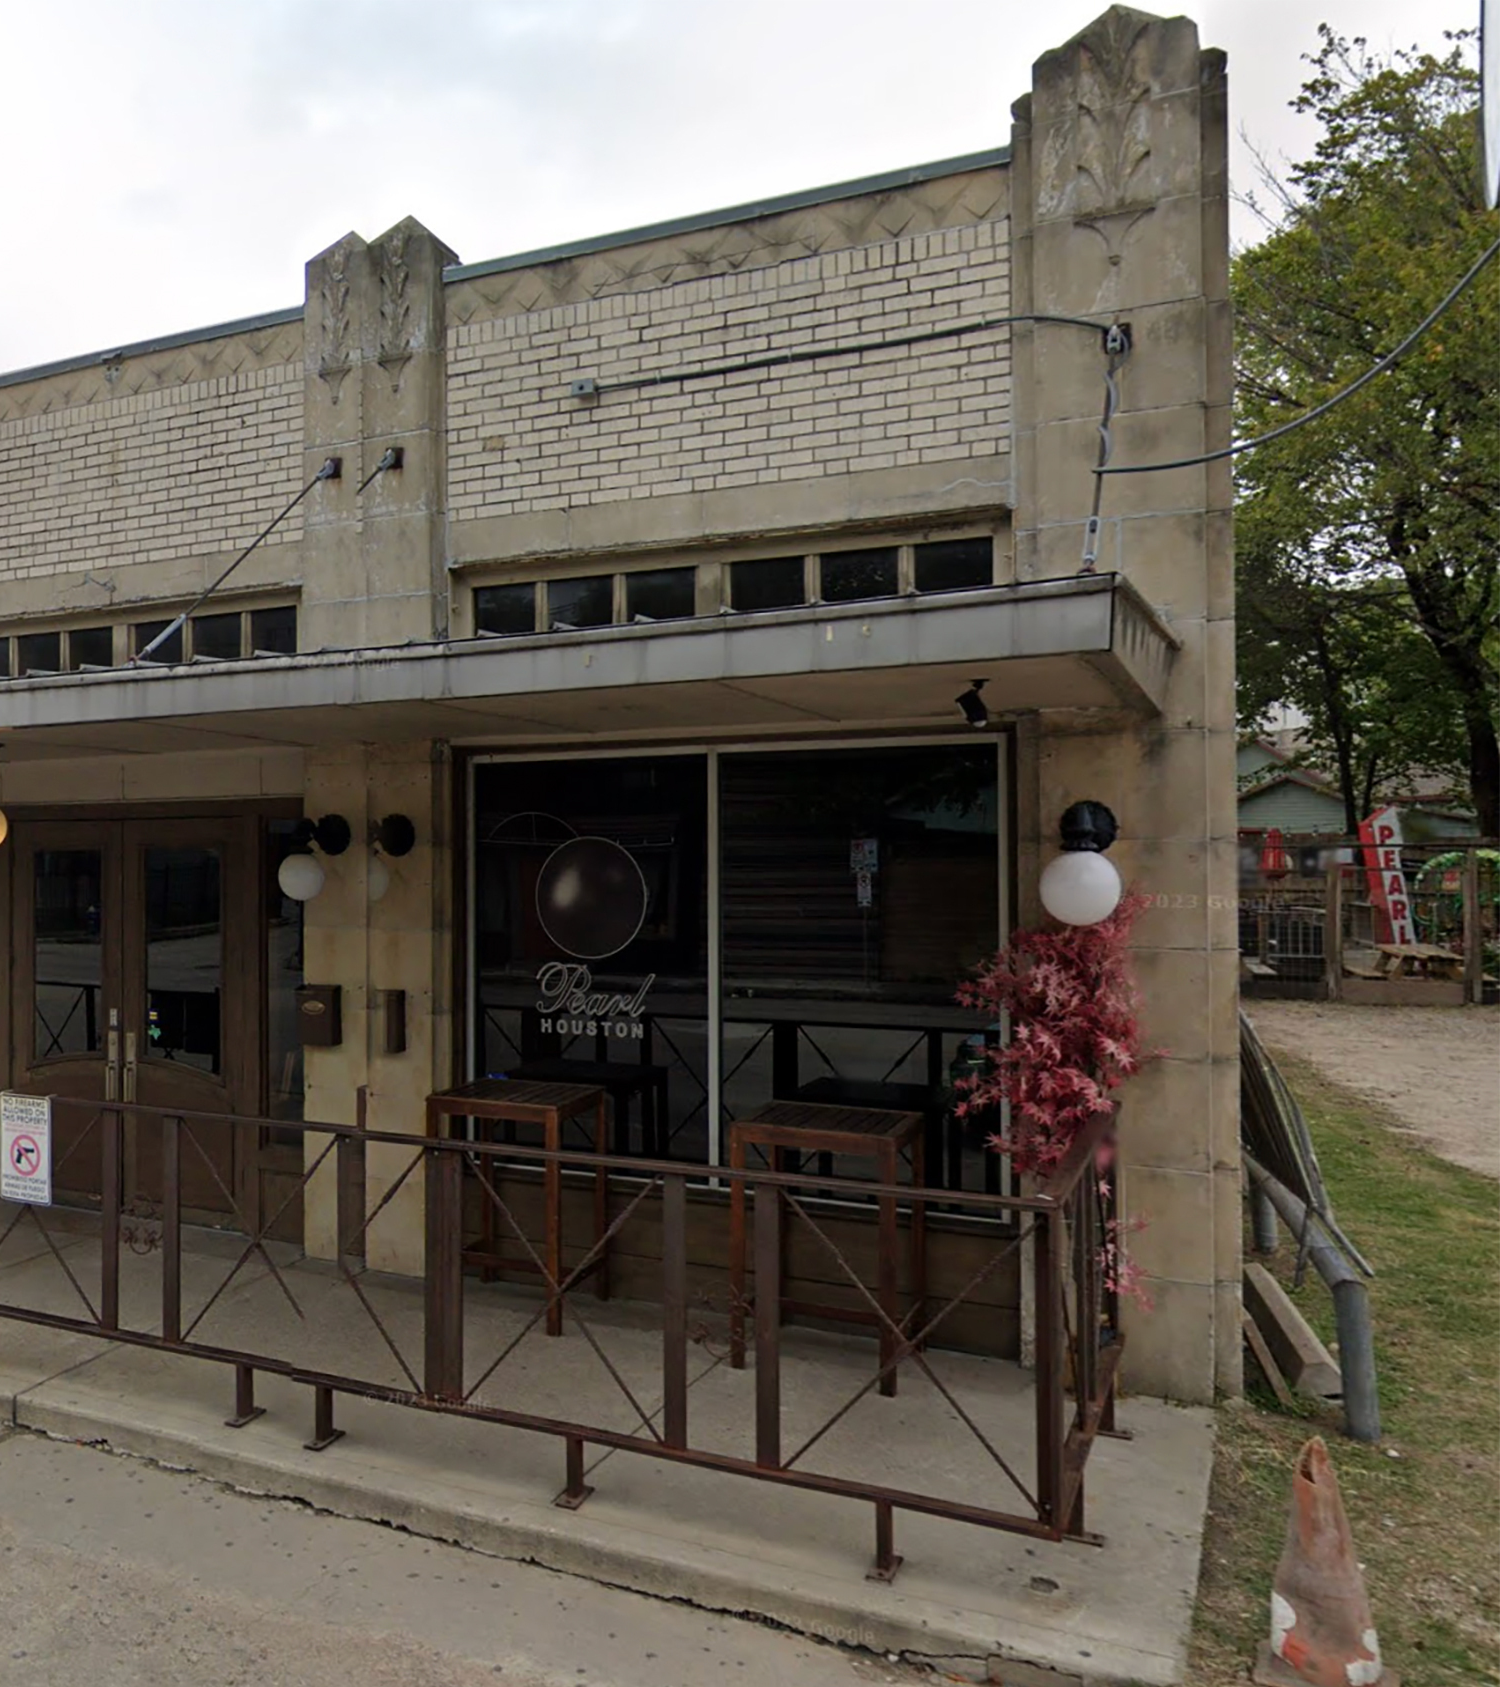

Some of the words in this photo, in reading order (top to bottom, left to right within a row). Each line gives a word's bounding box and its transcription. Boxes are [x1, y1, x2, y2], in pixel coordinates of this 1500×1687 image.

[1379, 825, 1411, 945] PEARL
[536, 962, 656, 1017] Pearl
[541, 1018, 644, 1039] HOUSTON
[3, 1106, 33, 1116] ALLOWED
[35, 1109, 46, 1117] ON
[15, 1099, 46, 1109] FIREARMS
[2, 1114, 15, 1122] THIS
[16, 1116, 47, 1126] PROPERTY
